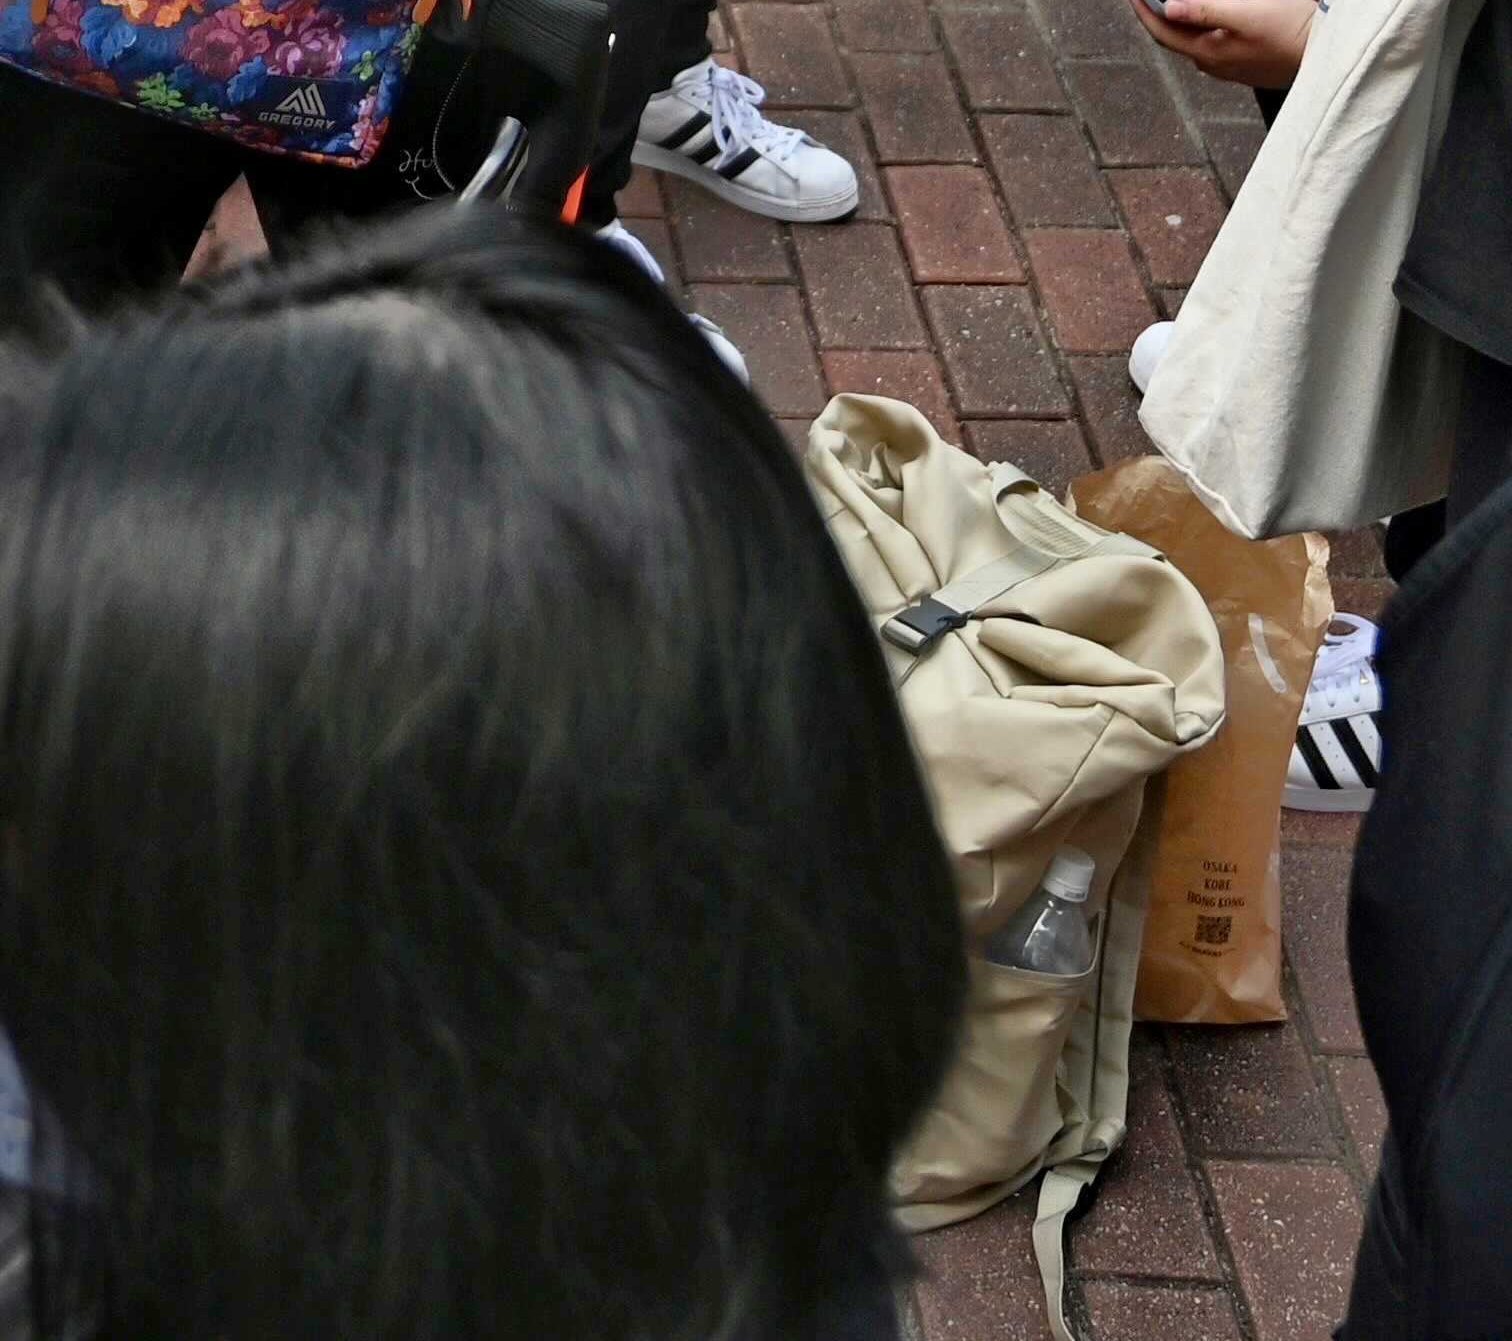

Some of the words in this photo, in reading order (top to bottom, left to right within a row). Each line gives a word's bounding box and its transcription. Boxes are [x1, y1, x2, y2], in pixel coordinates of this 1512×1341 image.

[258, 111, 337, 130] GREGORY
[1202, 860, 1238, 873] OSAKA
[1204, 877, 1232, 891] KOBE
[1186, 890, 1217, 909] HONG
[1217, 898, 1246, 909] KONG
